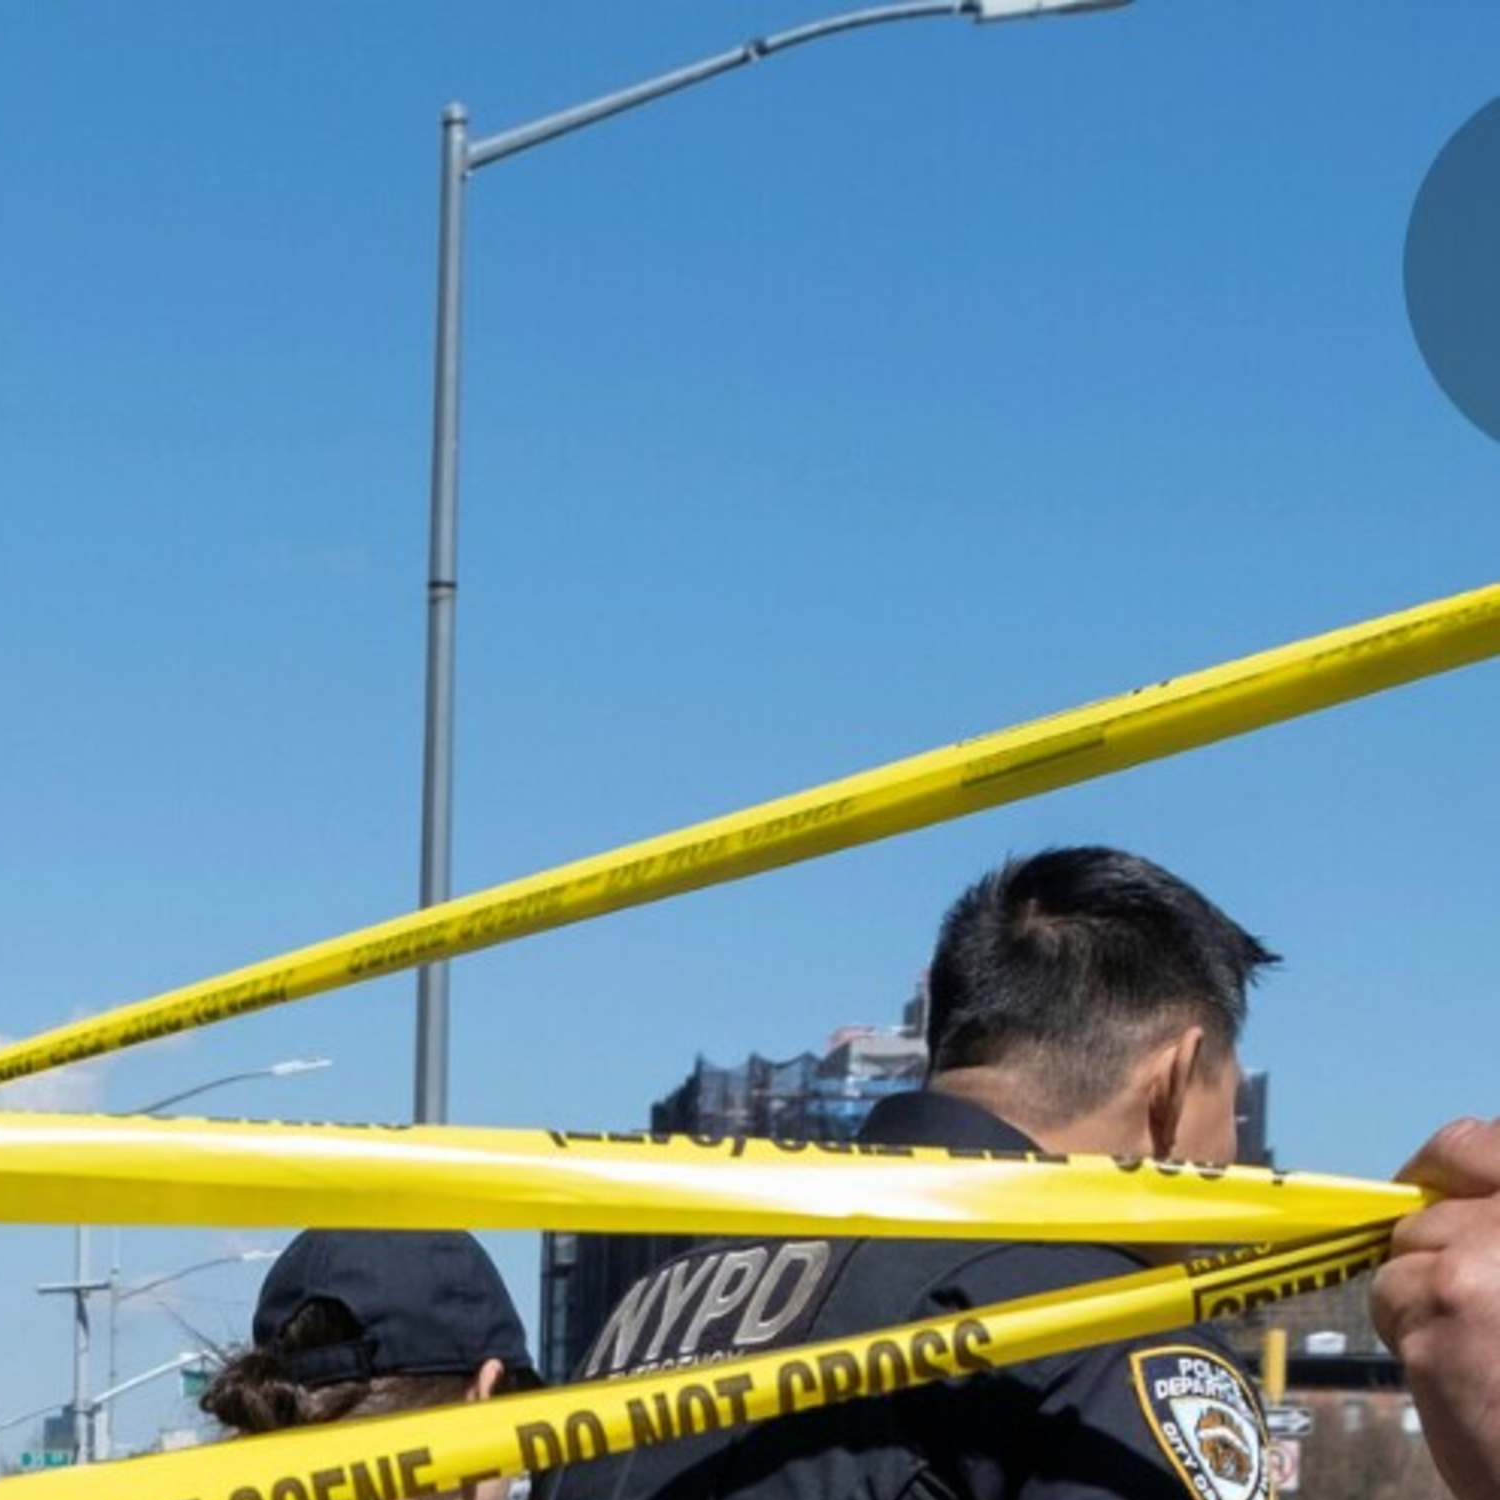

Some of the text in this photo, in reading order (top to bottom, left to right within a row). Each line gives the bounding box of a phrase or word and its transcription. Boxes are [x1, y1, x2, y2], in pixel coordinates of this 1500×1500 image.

[584, 1240, 830, 1379] NYPD
[515, 1409, 610, 1472] DO
[625, 1372, 757, 1448] NOT
[776, 1318, 997, 1412] CROSS
